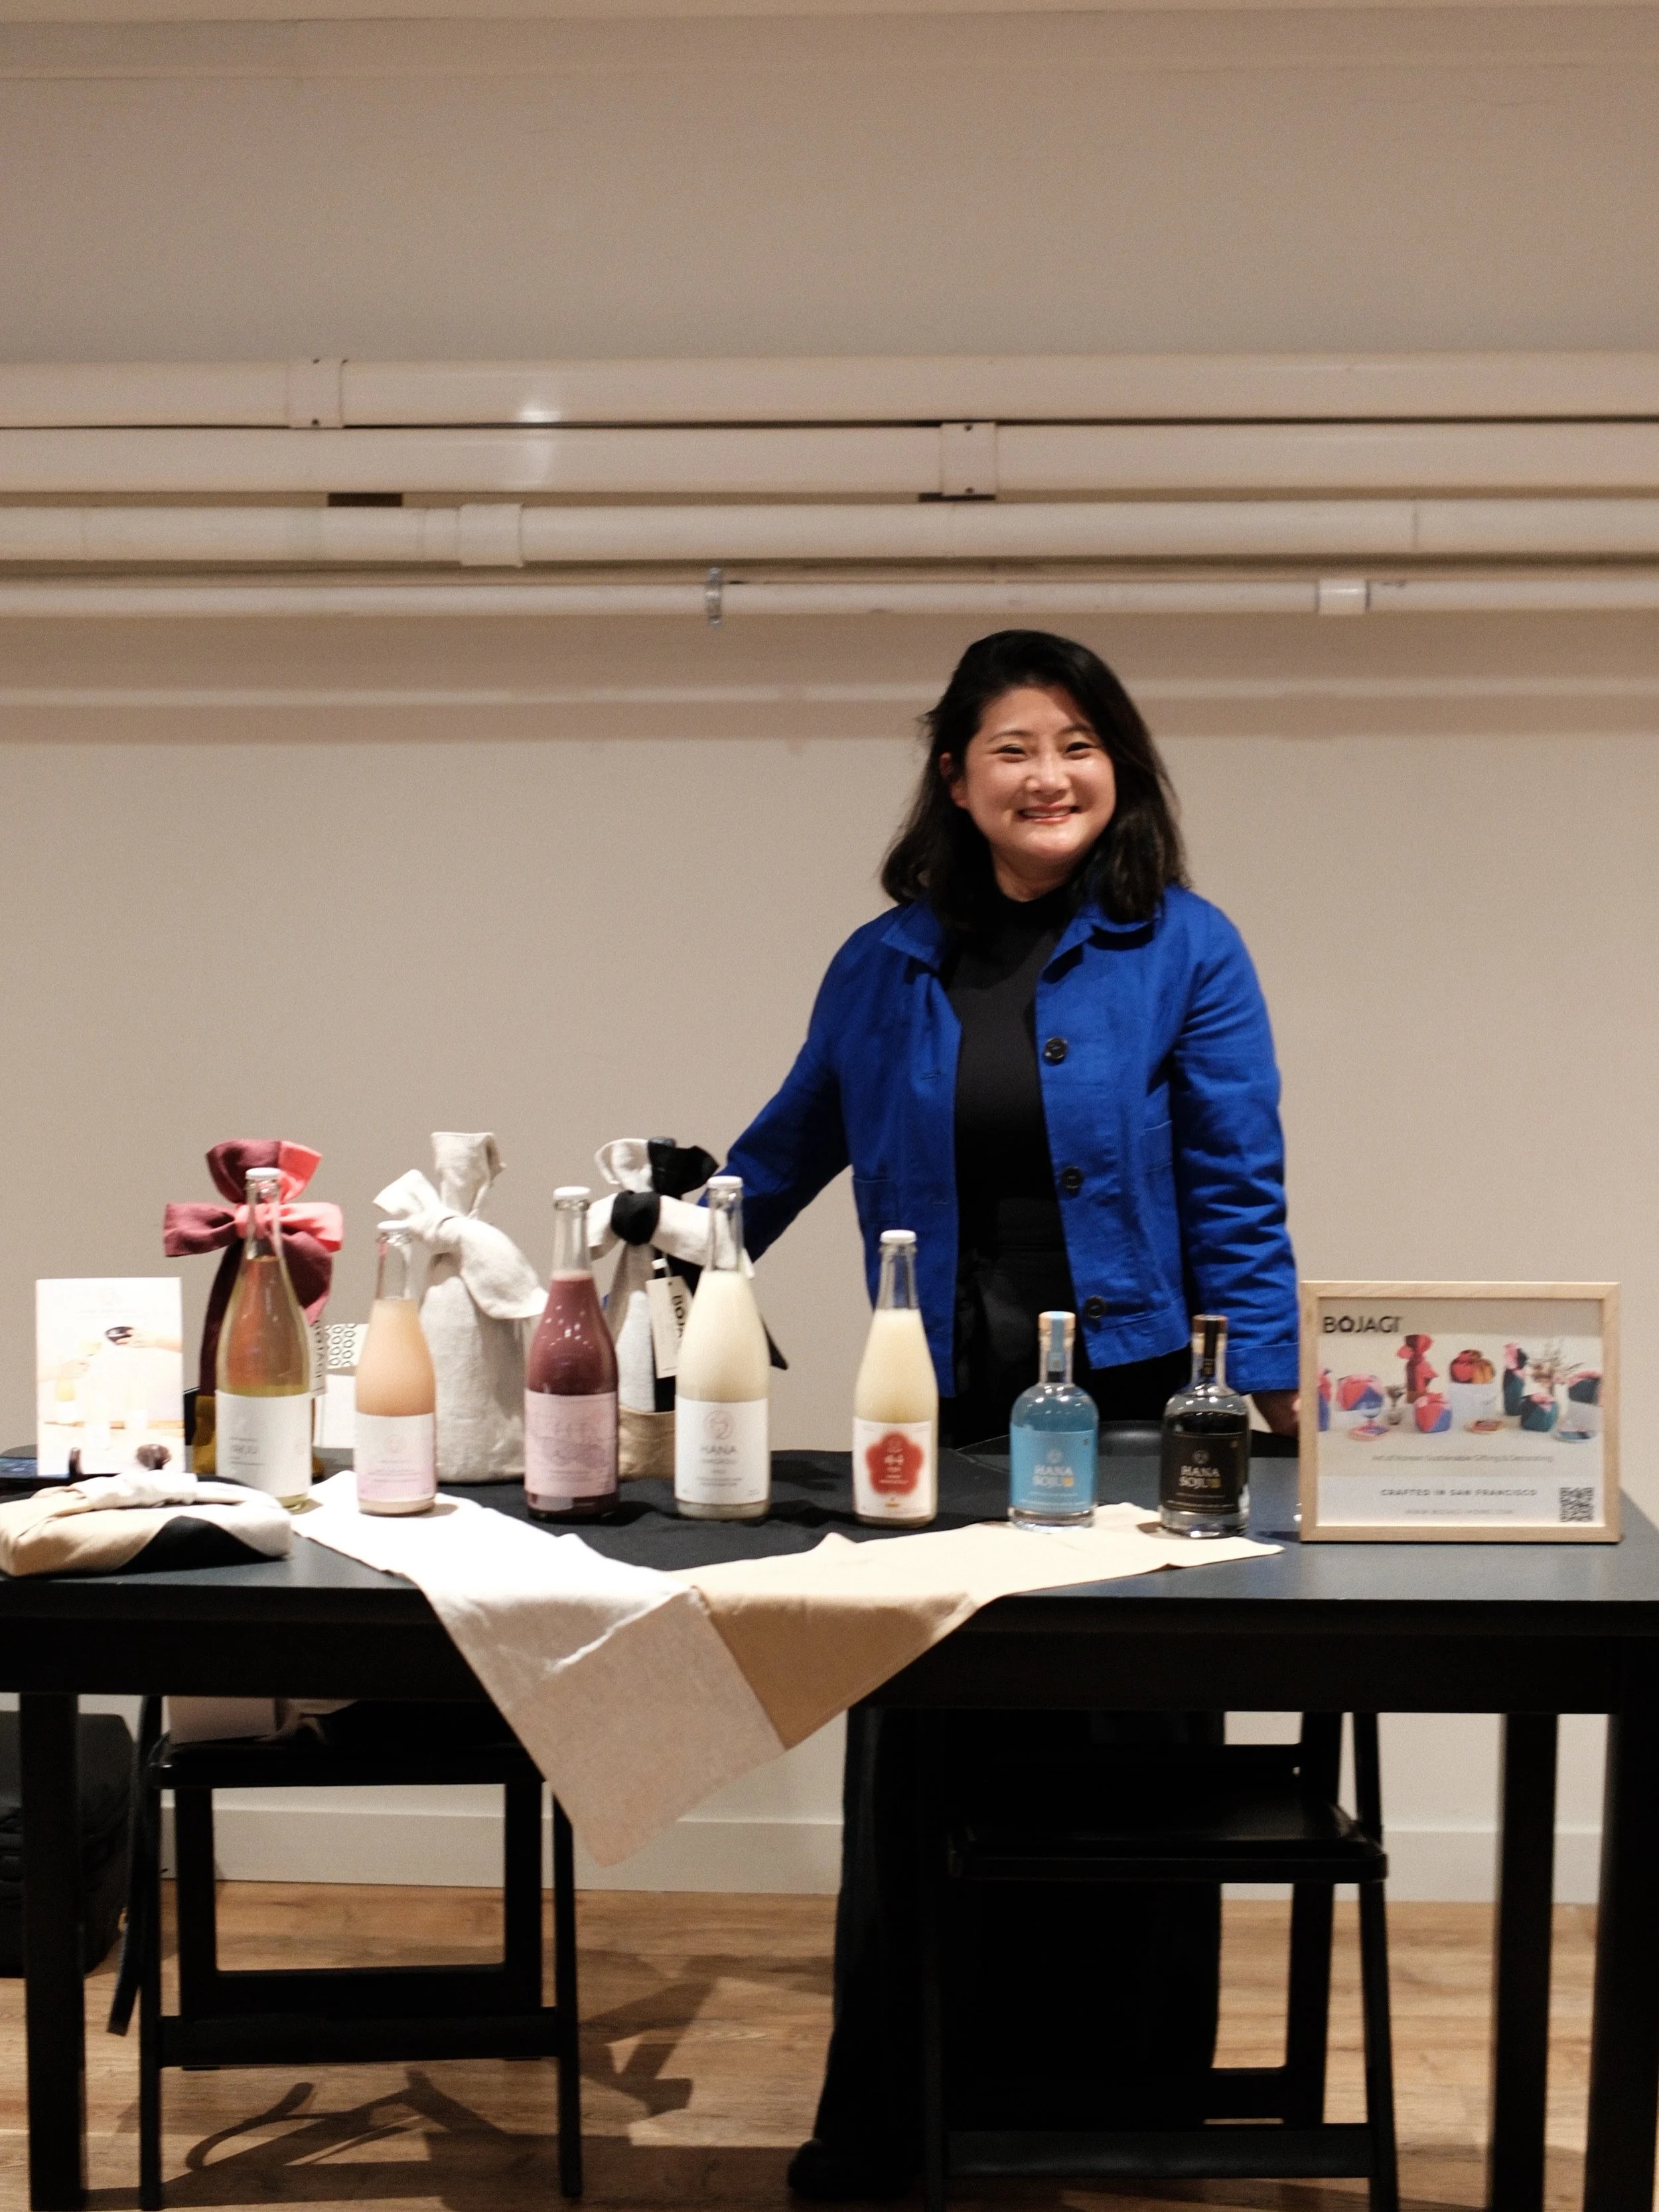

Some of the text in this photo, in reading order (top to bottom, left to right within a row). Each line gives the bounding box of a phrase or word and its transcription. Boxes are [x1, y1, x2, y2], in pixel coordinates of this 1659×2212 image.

[1323, 1315, 1402, 1333] BOJAGI
[1181, 1465, 1220, 1477] HANA
[1178, 1475, 1208, 1489] SOJU
